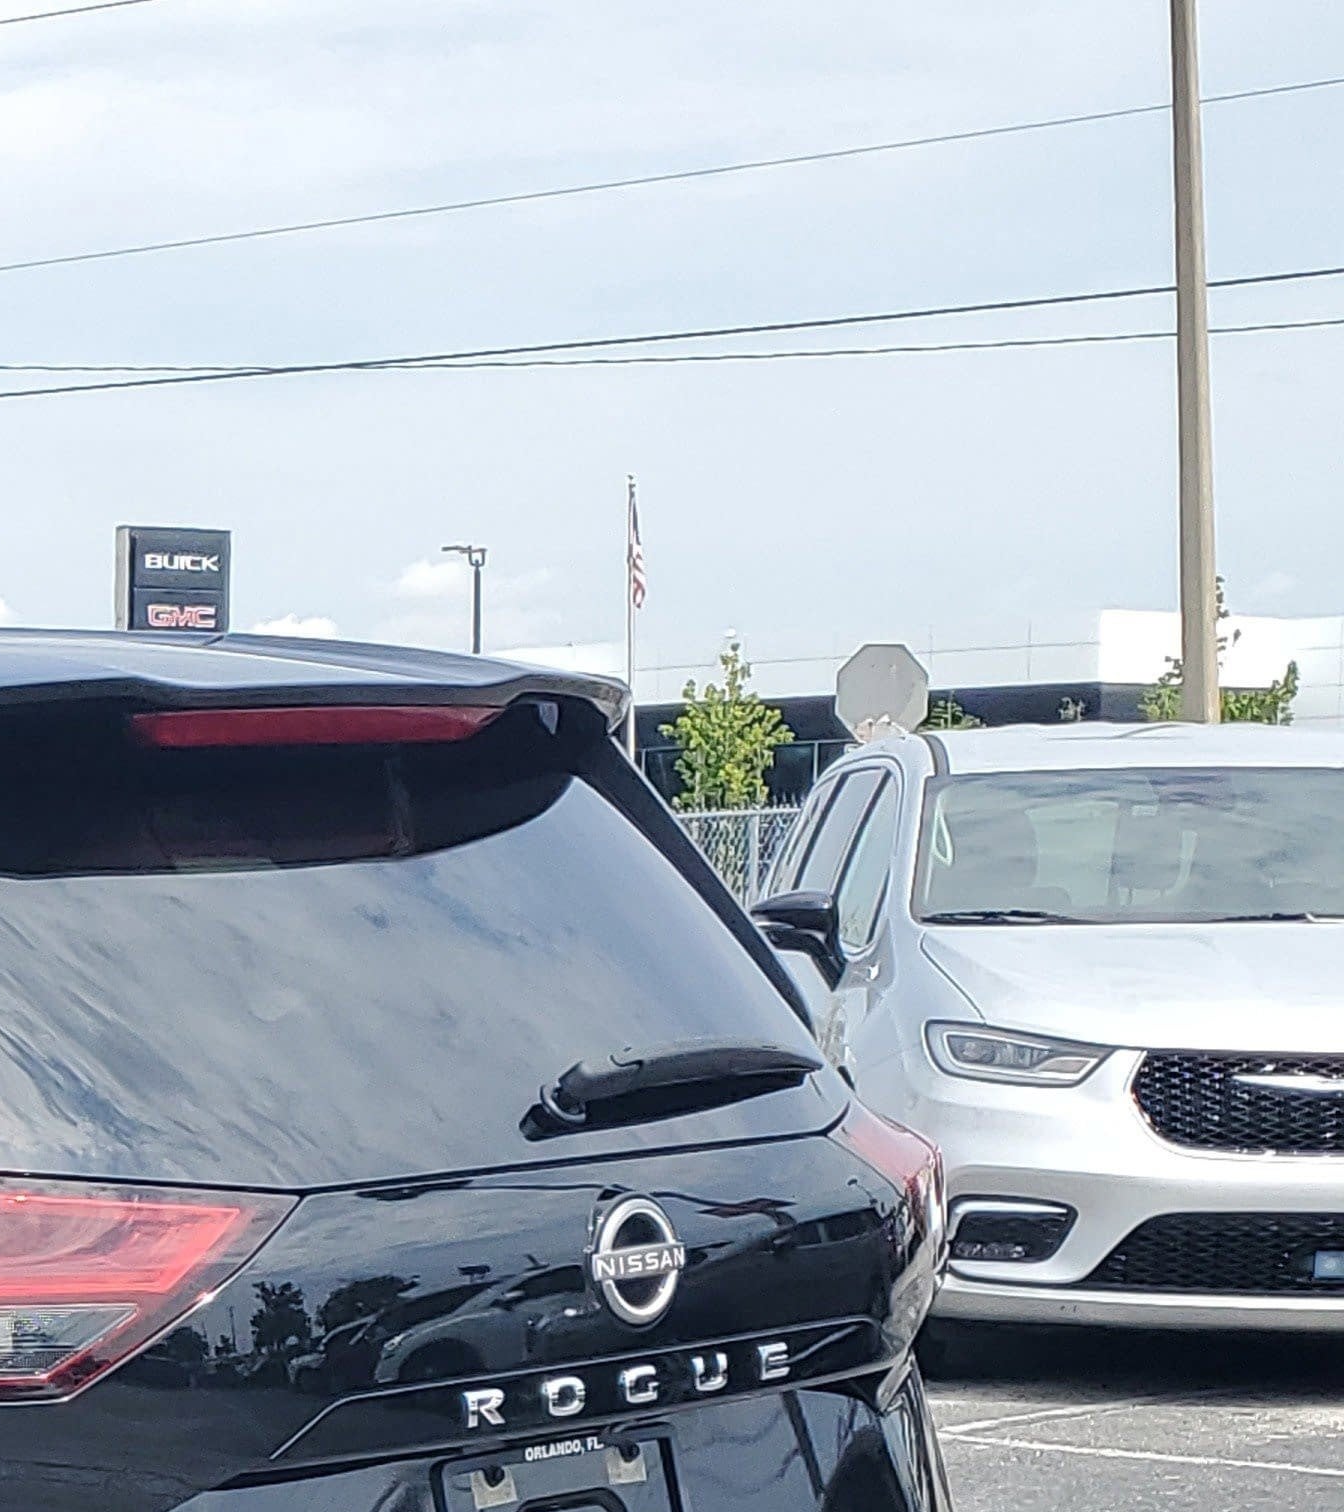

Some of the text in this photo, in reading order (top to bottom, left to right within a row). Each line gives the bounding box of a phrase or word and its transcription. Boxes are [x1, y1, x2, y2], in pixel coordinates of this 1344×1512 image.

[144, 553, 219, 572] BUICK
[147, 603, 217, 628] GMC
[595, 1246, 686, 1278] NISSAN
[463, 1341, 791, 1429] ROGUE
[524, 1439, 585, 1461] ORLANDO,
